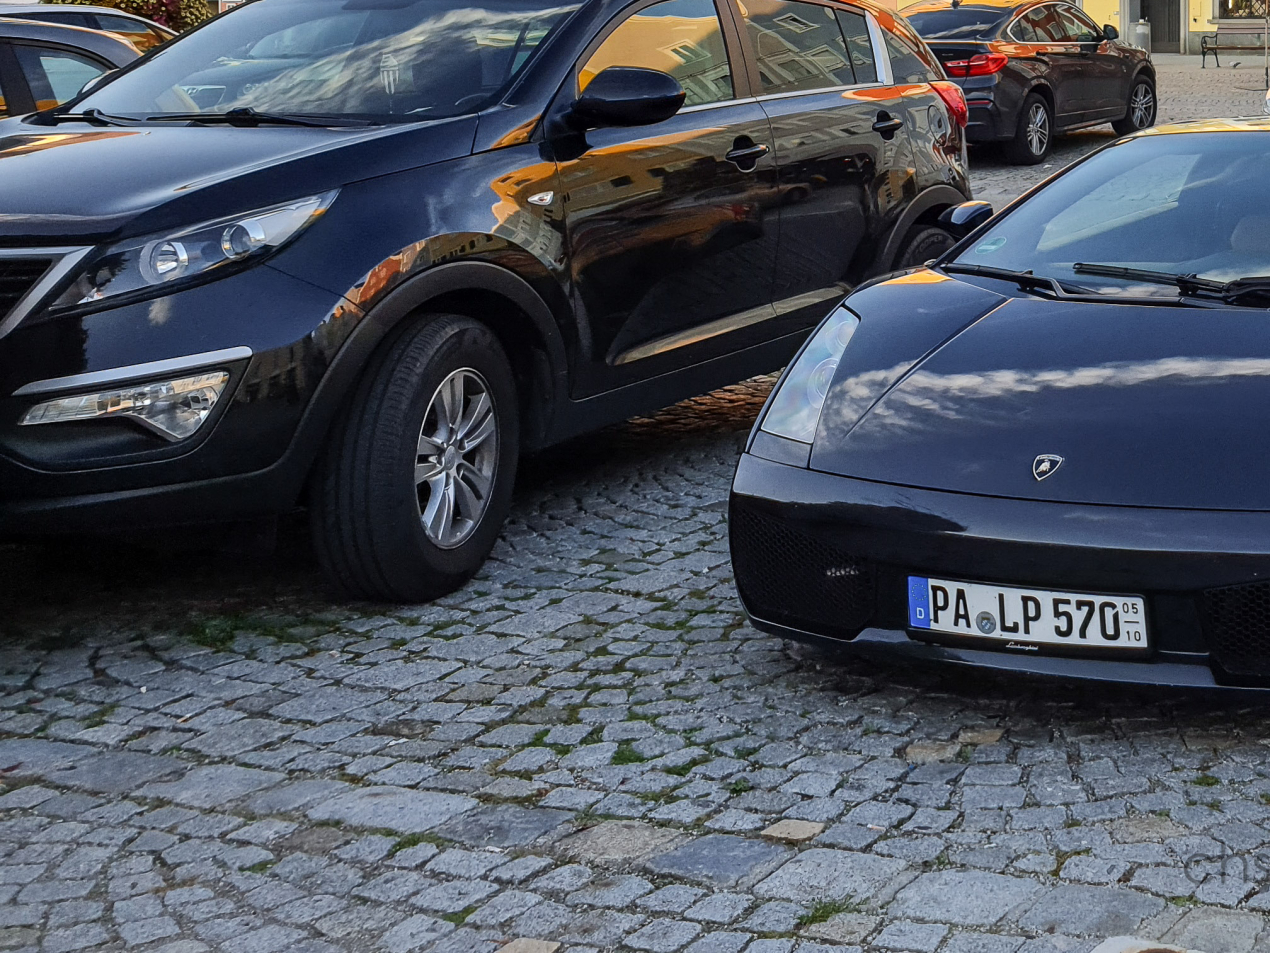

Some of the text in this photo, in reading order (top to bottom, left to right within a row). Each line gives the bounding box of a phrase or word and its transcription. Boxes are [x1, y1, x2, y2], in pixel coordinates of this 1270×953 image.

[916, 607, 925, 620] D
[931, 585, 1121, 642] PA LP 570
[1122, 602, 1140, 615] 05
[1126, 630, 1142, 642] 10
